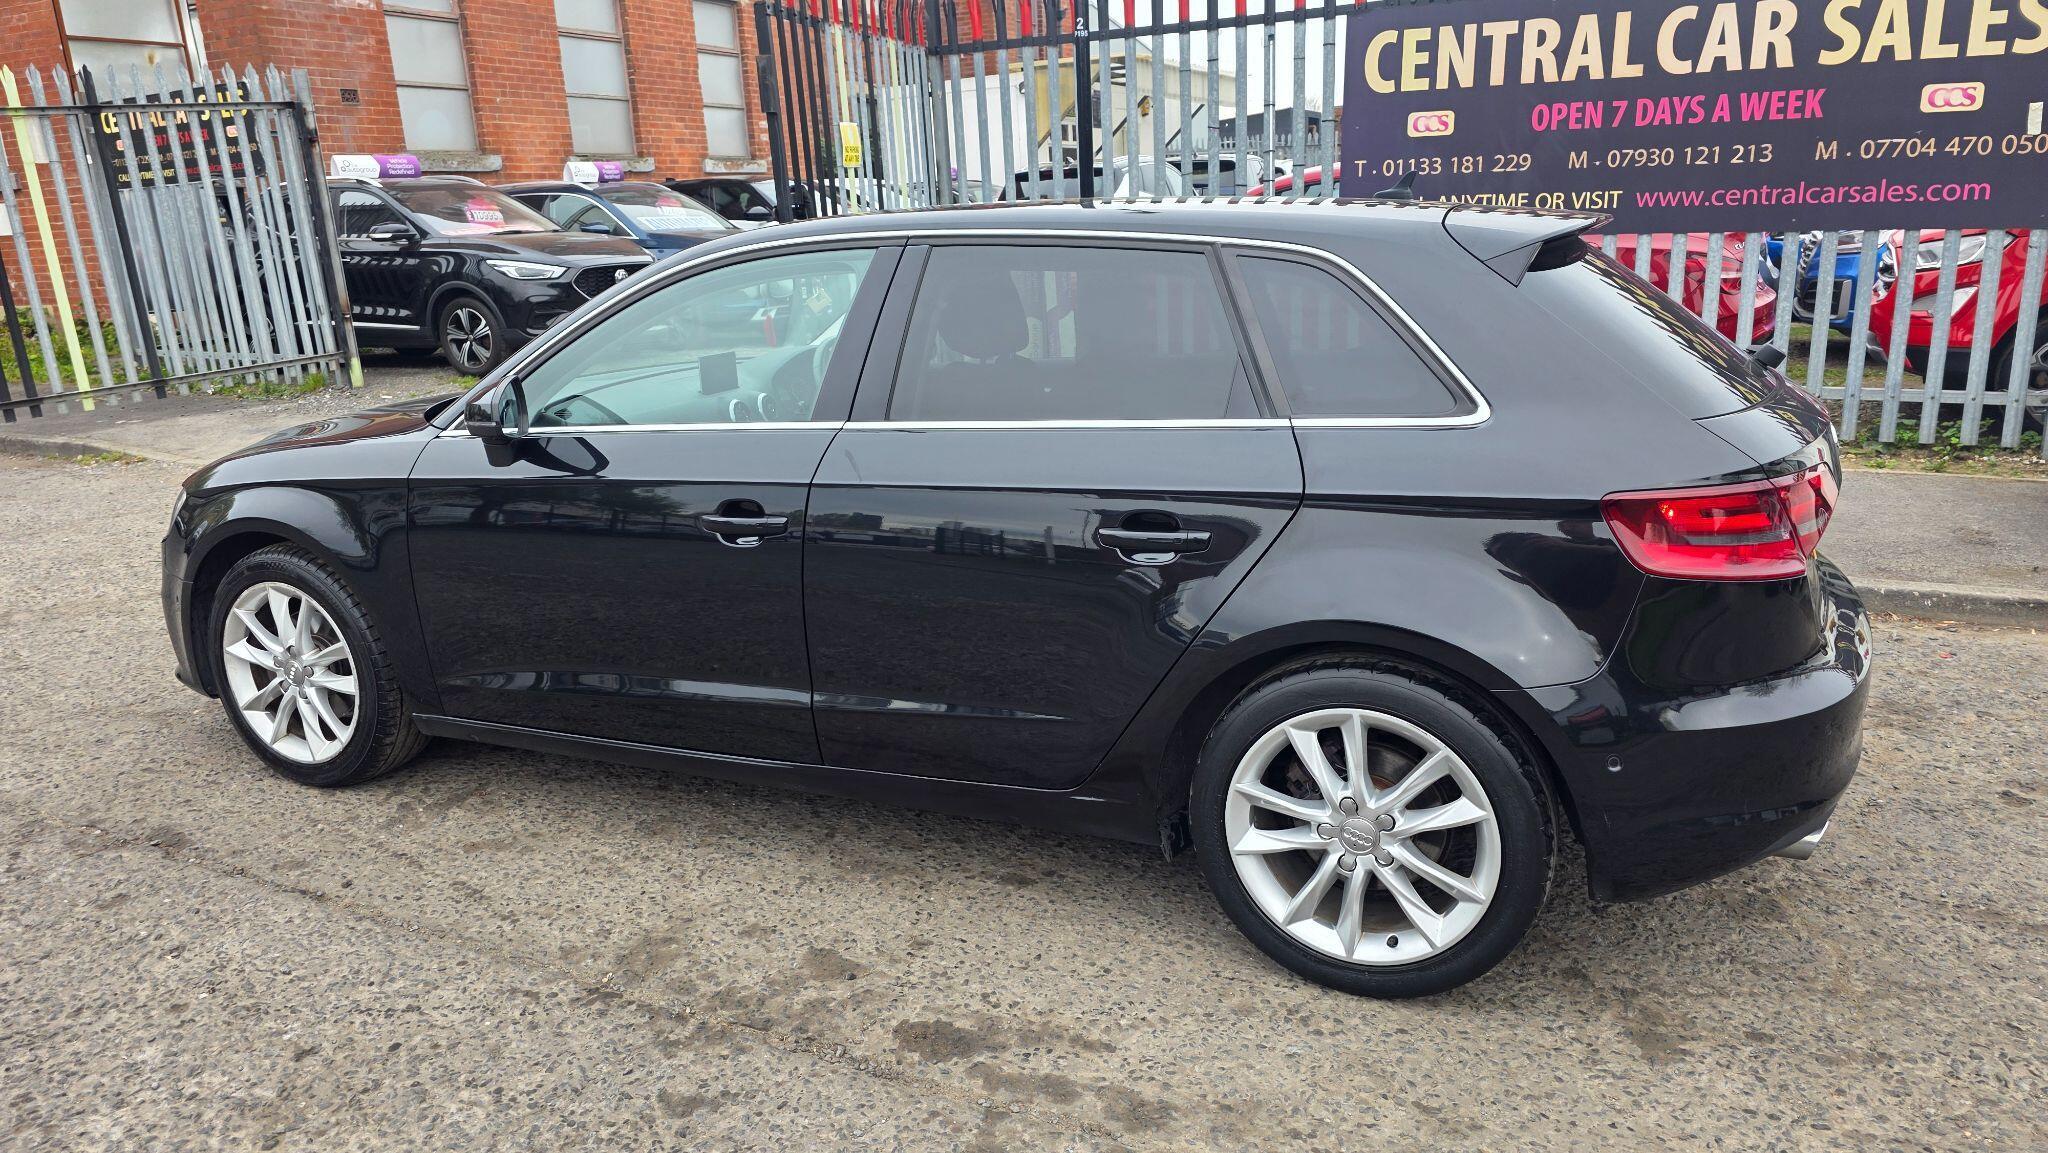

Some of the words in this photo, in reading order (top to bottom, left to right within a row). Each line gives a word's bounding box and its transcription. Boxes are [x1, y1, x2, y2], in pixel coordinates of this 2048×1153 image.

[1076, 17, 1084, 29] 2
[1364, 10, 1644, 93] CENTRAL
[1657, 0, 1797, 75] CAR
[1817, 0, 2048, 65] SALES
[1531, 101, 1604, 131] OPEN
[1611, 99, 1629, 127] 7
[1635, 94, 1706, 126] DAYS
[1711, 93, 1731, 123] A
[1740, 88, 1827, 122] WEEK
[1568, 150, 1589, 169] M
[1607, 147, 1675, 168] 07930
[1684, 145, 1720, 165] 121
[1730, 143, 1774, 164] 213
[1814, 140, 1839, 161] M
[1859, 137, 1938, 159] 07704
[1943, 134, 1993, 156] 470
[2001, 133, 2048, 155] 050
[1354, 159, 1368, 177] T
[1382, 157, 1442, 177] 01133
[1450, 155, 1484, 174] 181
[1490, 153, 1533, 173] 229
[1535, 192, 1565, 209] OR
[1571, 190, 1623, 209] VISIT
[1635, 178, 1992, 208] www.centralcarsales.com
